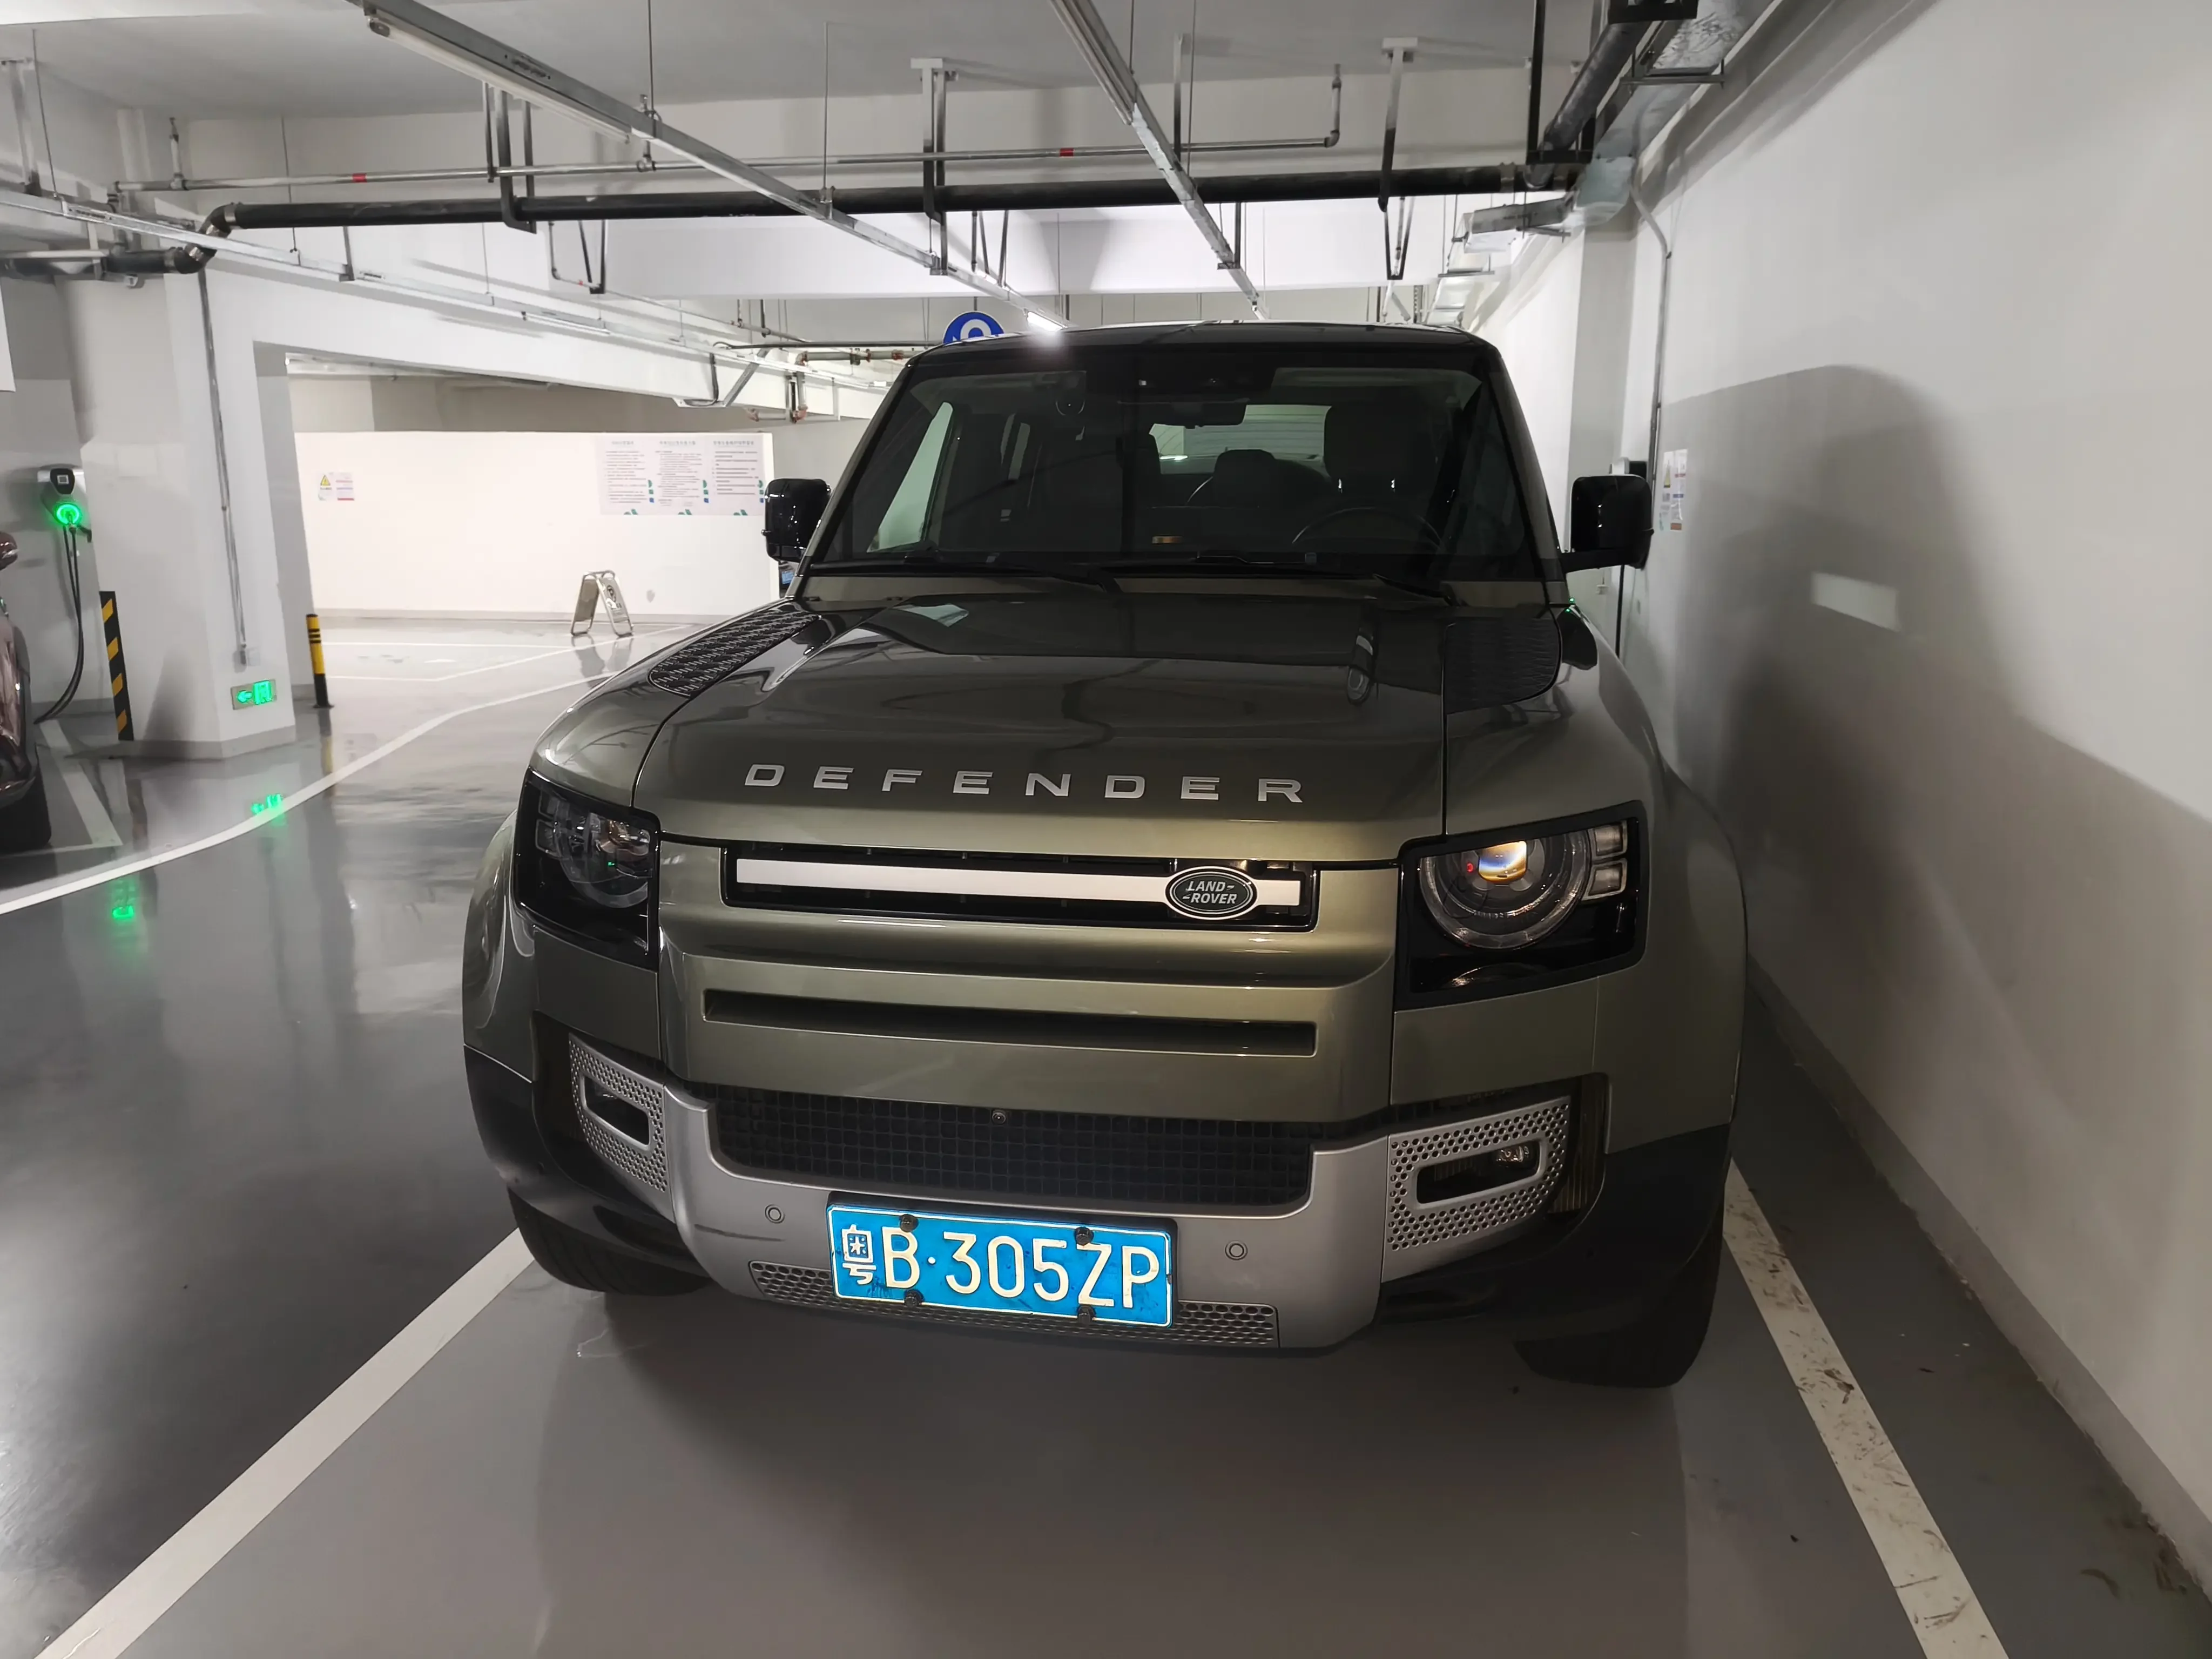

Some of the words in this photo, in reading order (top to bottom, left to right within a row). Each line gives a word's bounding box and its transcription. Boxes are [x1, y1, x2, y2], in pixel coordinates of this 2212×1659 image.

[744, 763, 1303, 802] DEFENDER
[1186, 881, 1226, 892] LAND
[1190, 893, 1237, 904] ROVER
